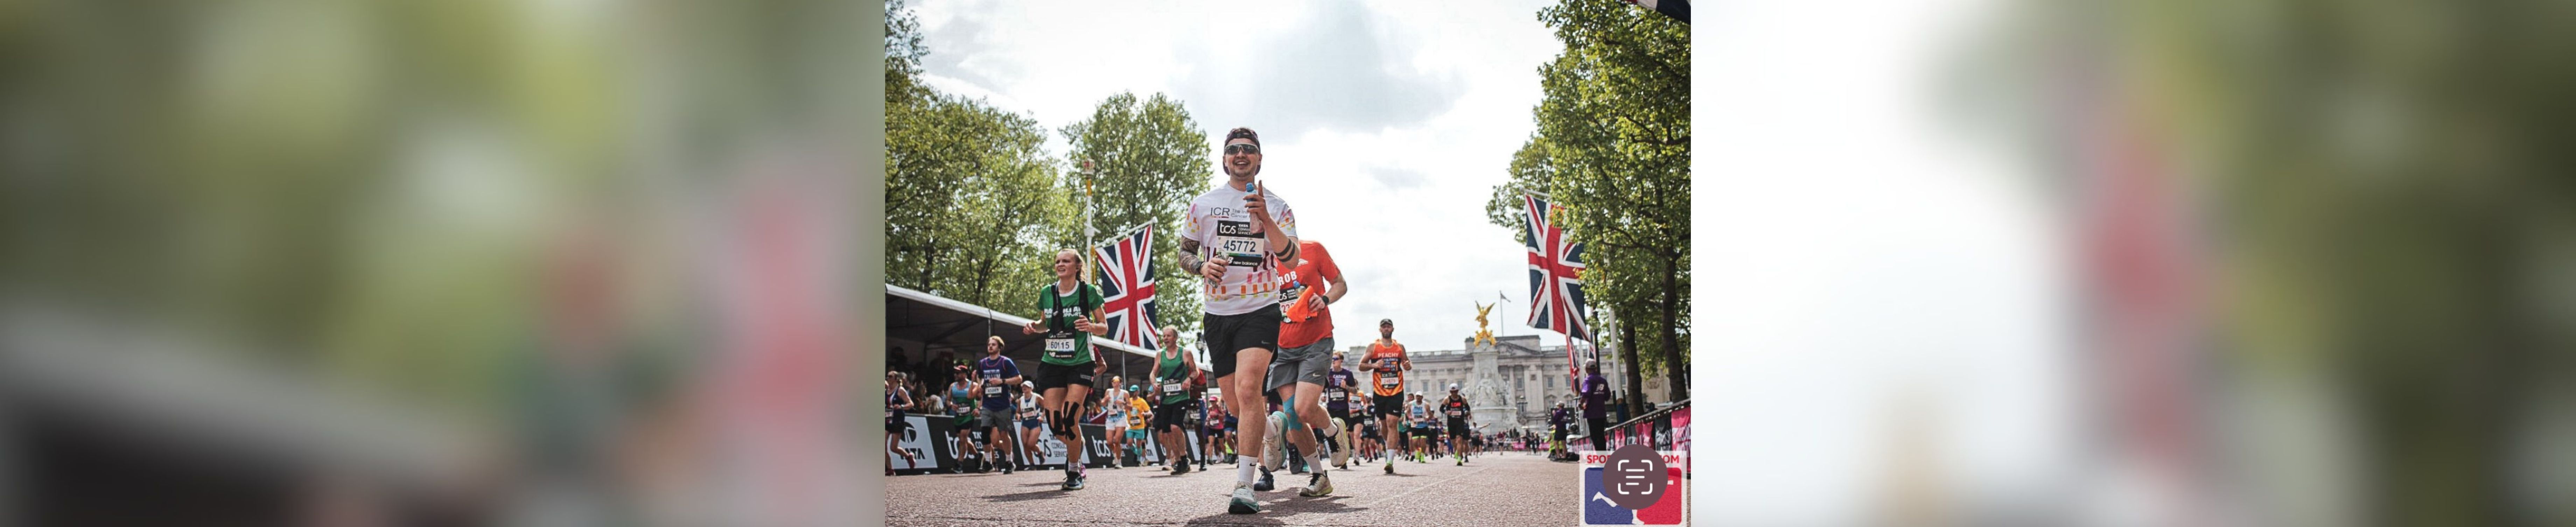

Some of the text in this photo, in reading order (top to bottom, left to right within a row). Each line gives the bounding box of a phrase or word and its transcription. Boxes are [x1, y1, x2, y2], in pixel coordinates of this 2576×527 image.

[1211, 208, 1230, 216] ICR
[1220, 223, 1236, 234] tcs
[1224, 240, 1256, 252] 45772
[1278, 271, 1297, 286] ROB
[1091, 435, 1111, 457] tcs
